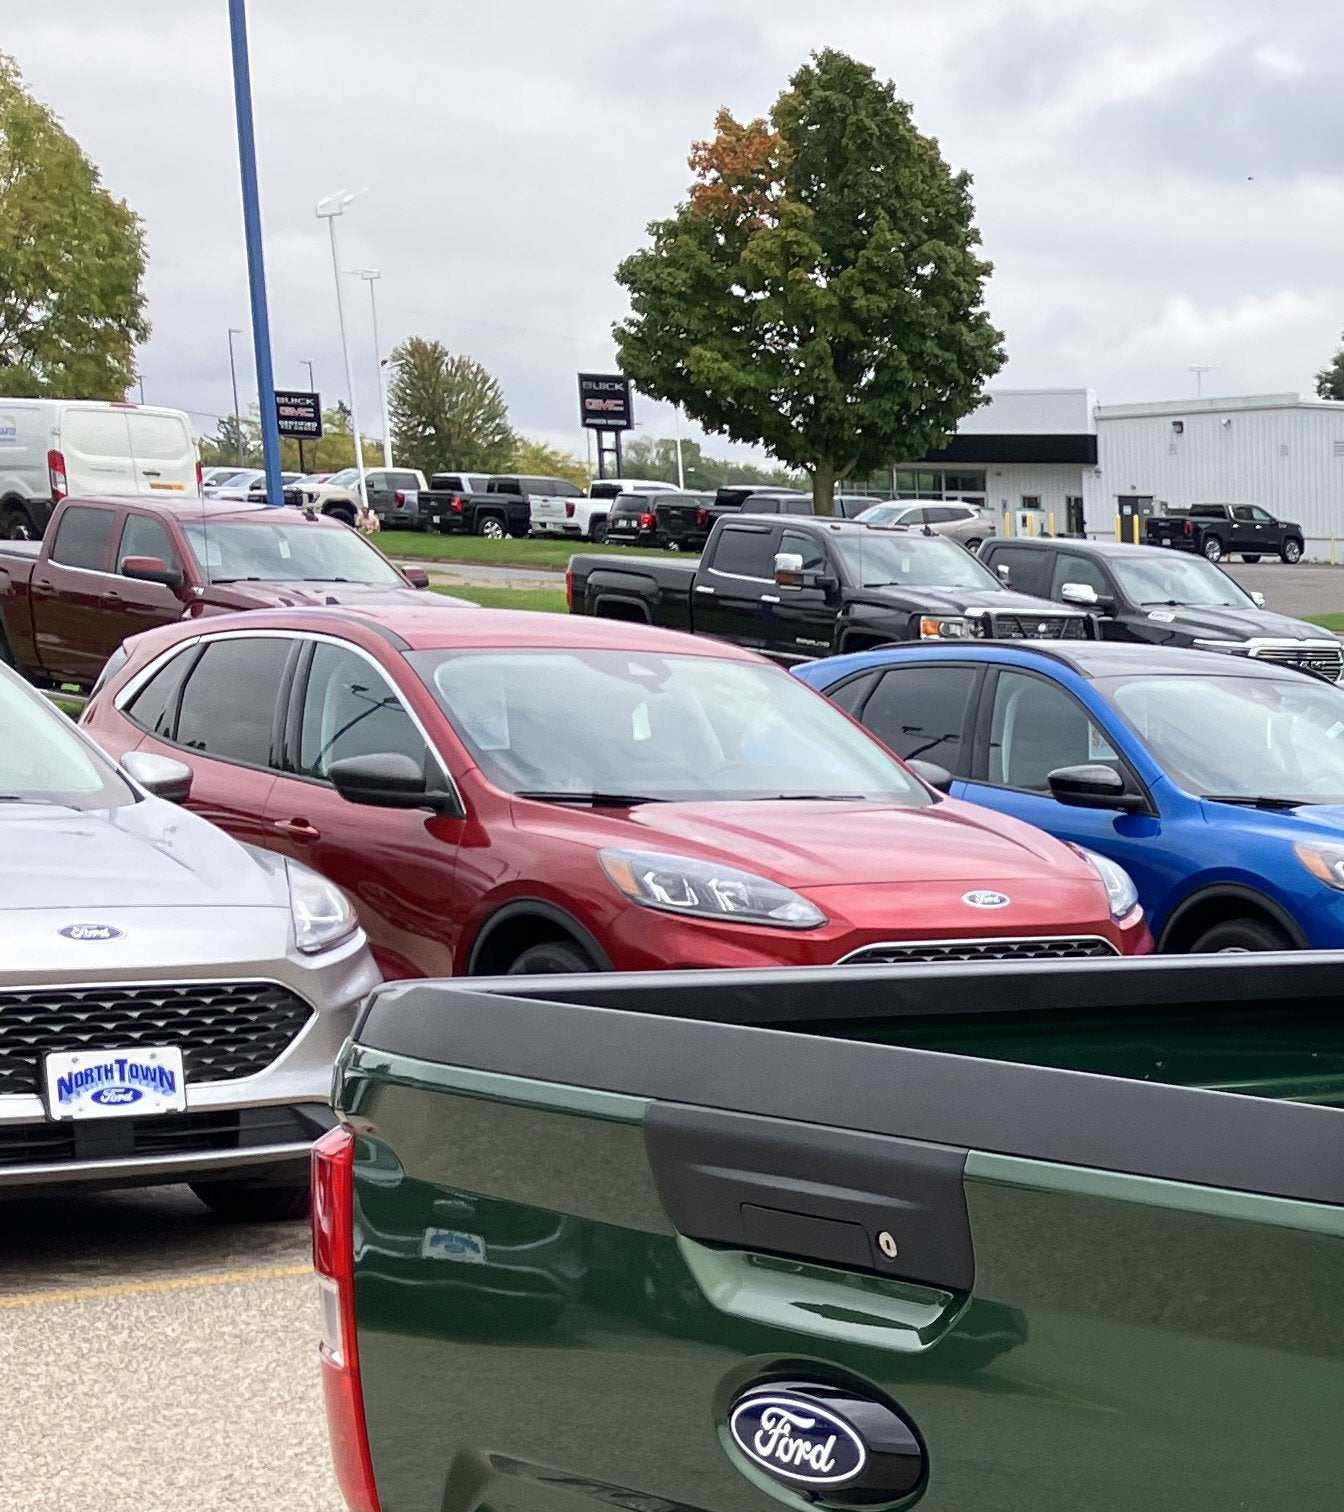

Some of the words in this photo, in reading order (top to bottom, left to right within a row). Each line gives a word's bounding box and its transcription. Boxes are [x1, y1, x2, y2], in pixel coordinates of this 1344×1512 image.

[582, 381, 625, 391] BUICK
[276, 396, 315, 406] BUICK
[585, 398, 625, 411] GMC
[279, 406, 315, 418] GMC
[99, 1088, 134, 1104] Ford
[754, 1406, 838, 1474] Ford
